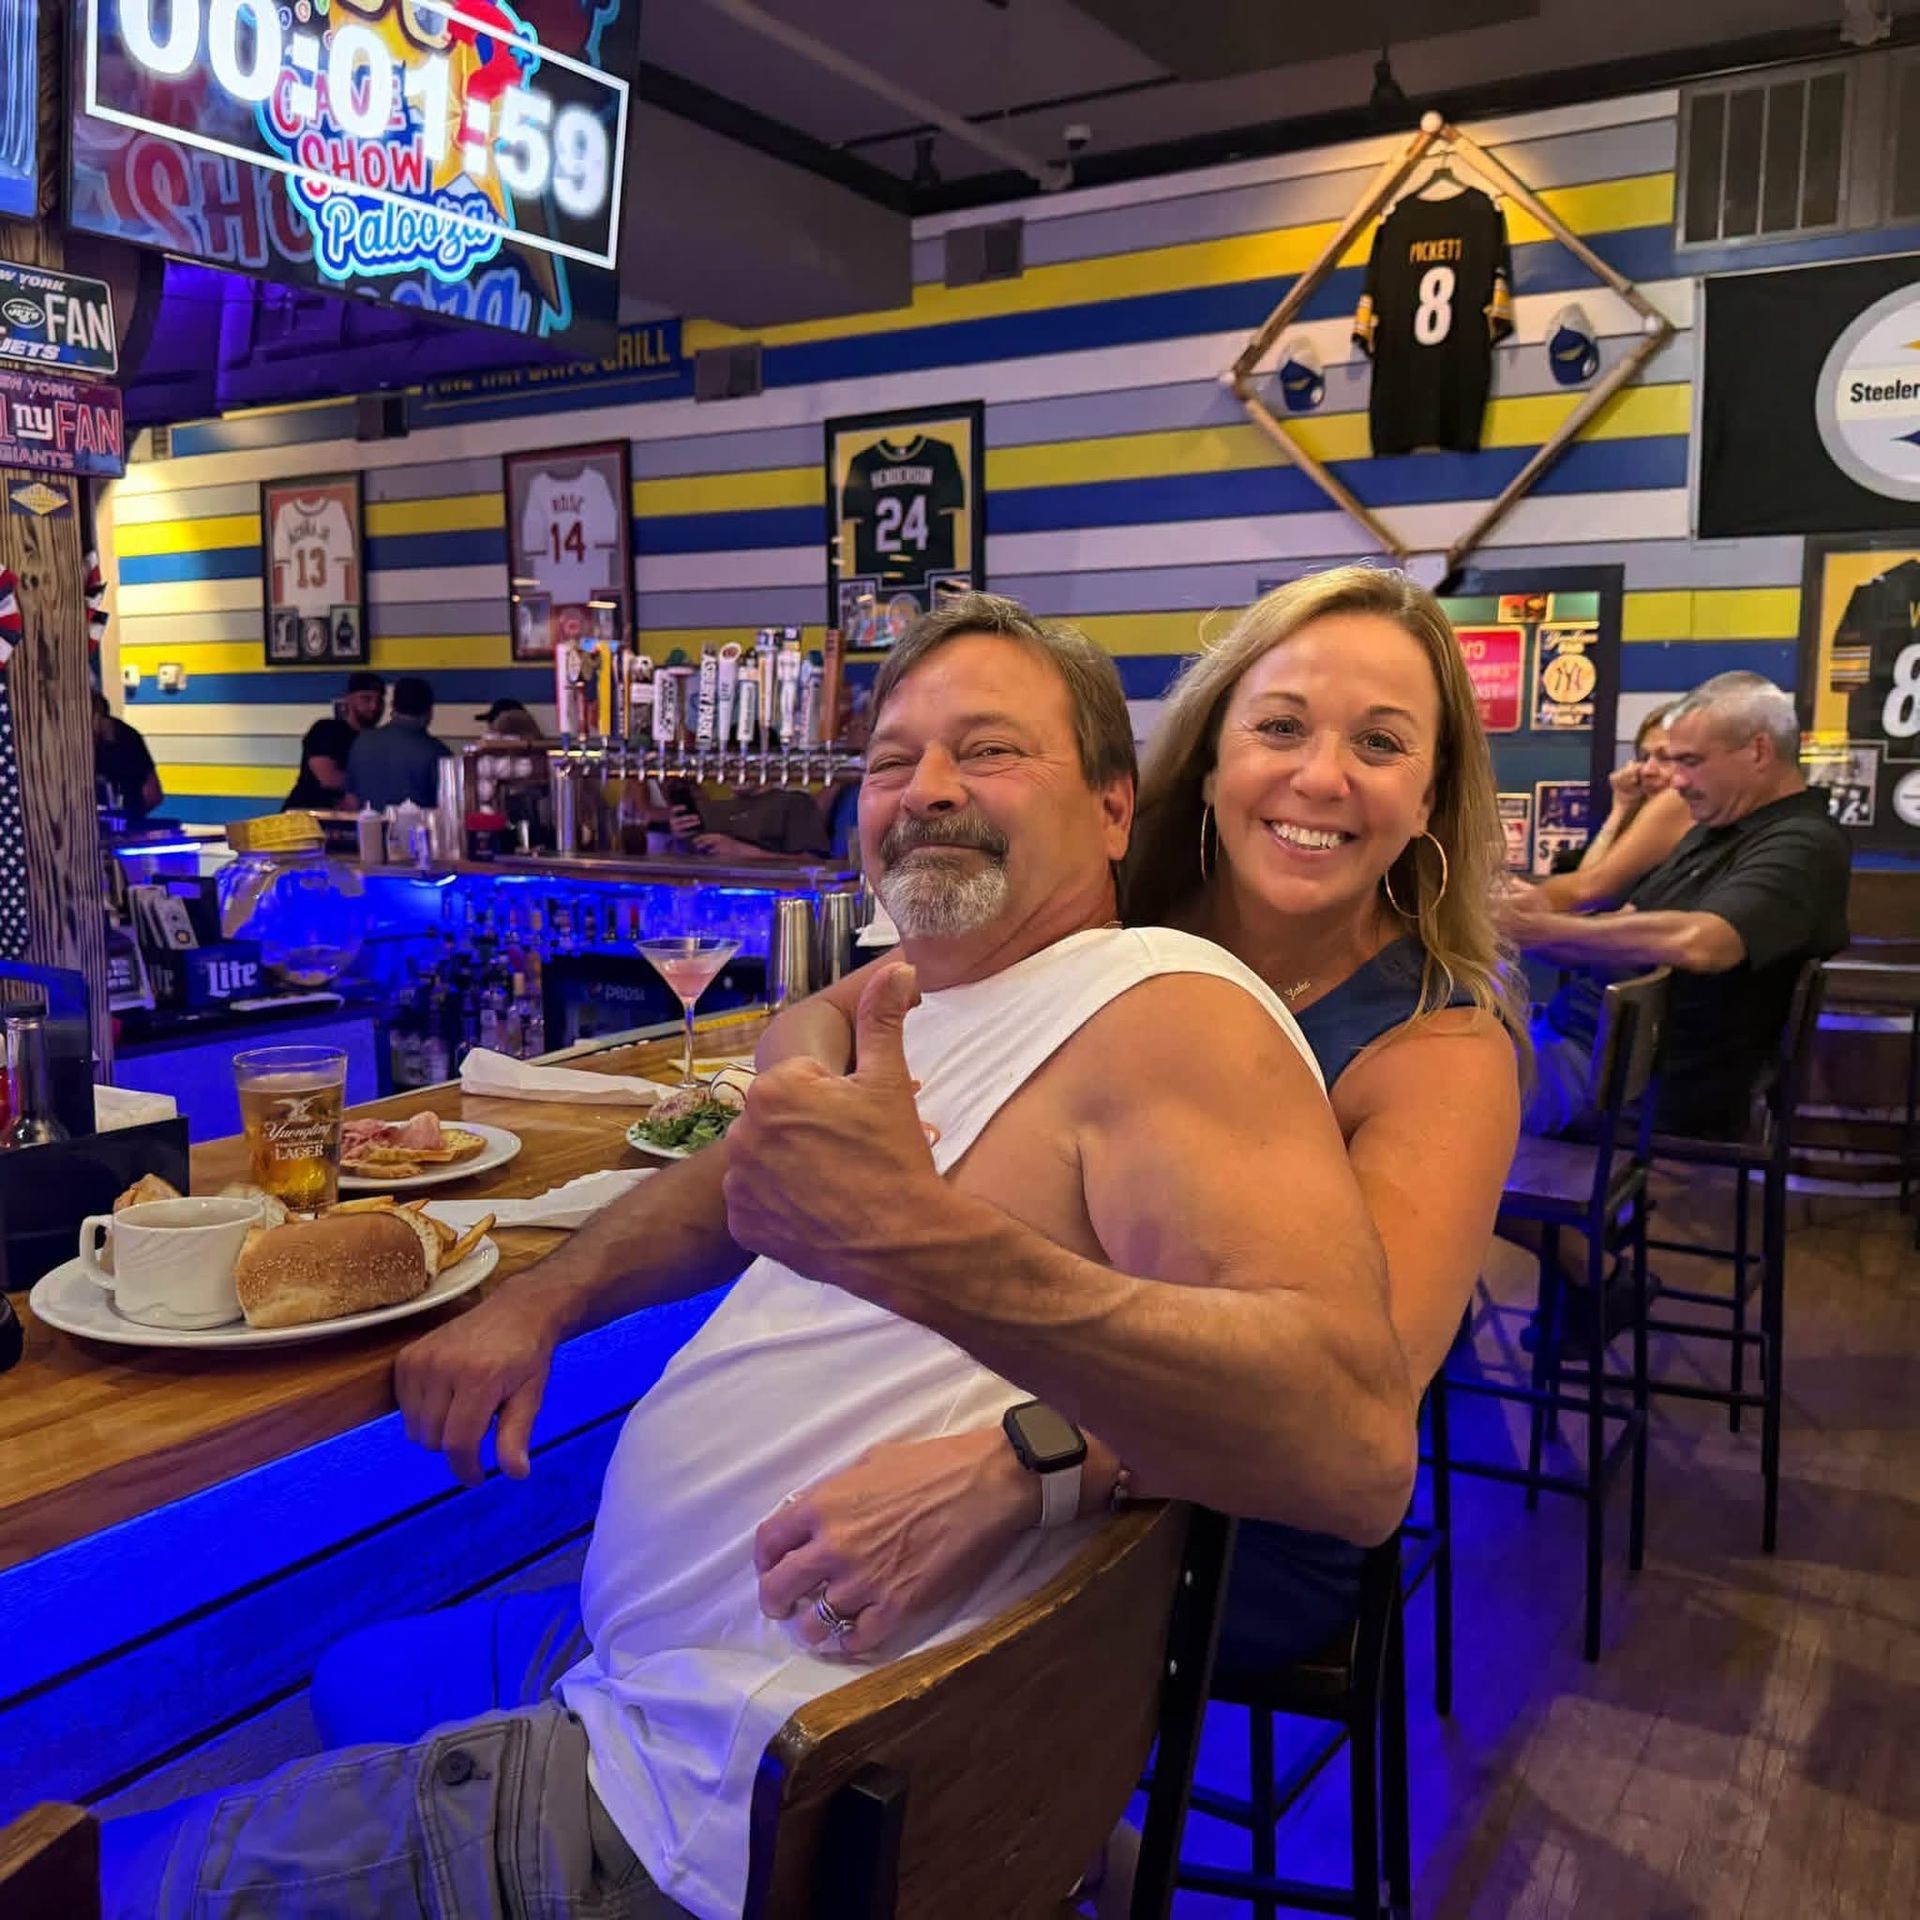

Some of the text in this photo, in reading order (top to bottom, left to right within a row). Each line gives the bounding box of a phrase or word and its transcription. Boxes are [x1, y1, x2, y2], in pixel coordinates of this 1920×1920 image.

[298, 131, 430, 199] SHOW
[19, 272, 66, 292] YORK
[44, 293, 114, 353] FAN
[1414, 266, 1456, 346] 8
[54, 400, 121, 455] FAN
[550, 520, 586, 564] 14
[874, 494, 930, 553] 24
[297, 546, 327, 590] 13
[207, 960, 258, 998] Lite
[263, 1120, 332, 1142] Yuengling
[275, 1143, 325, 1161] LAGER
